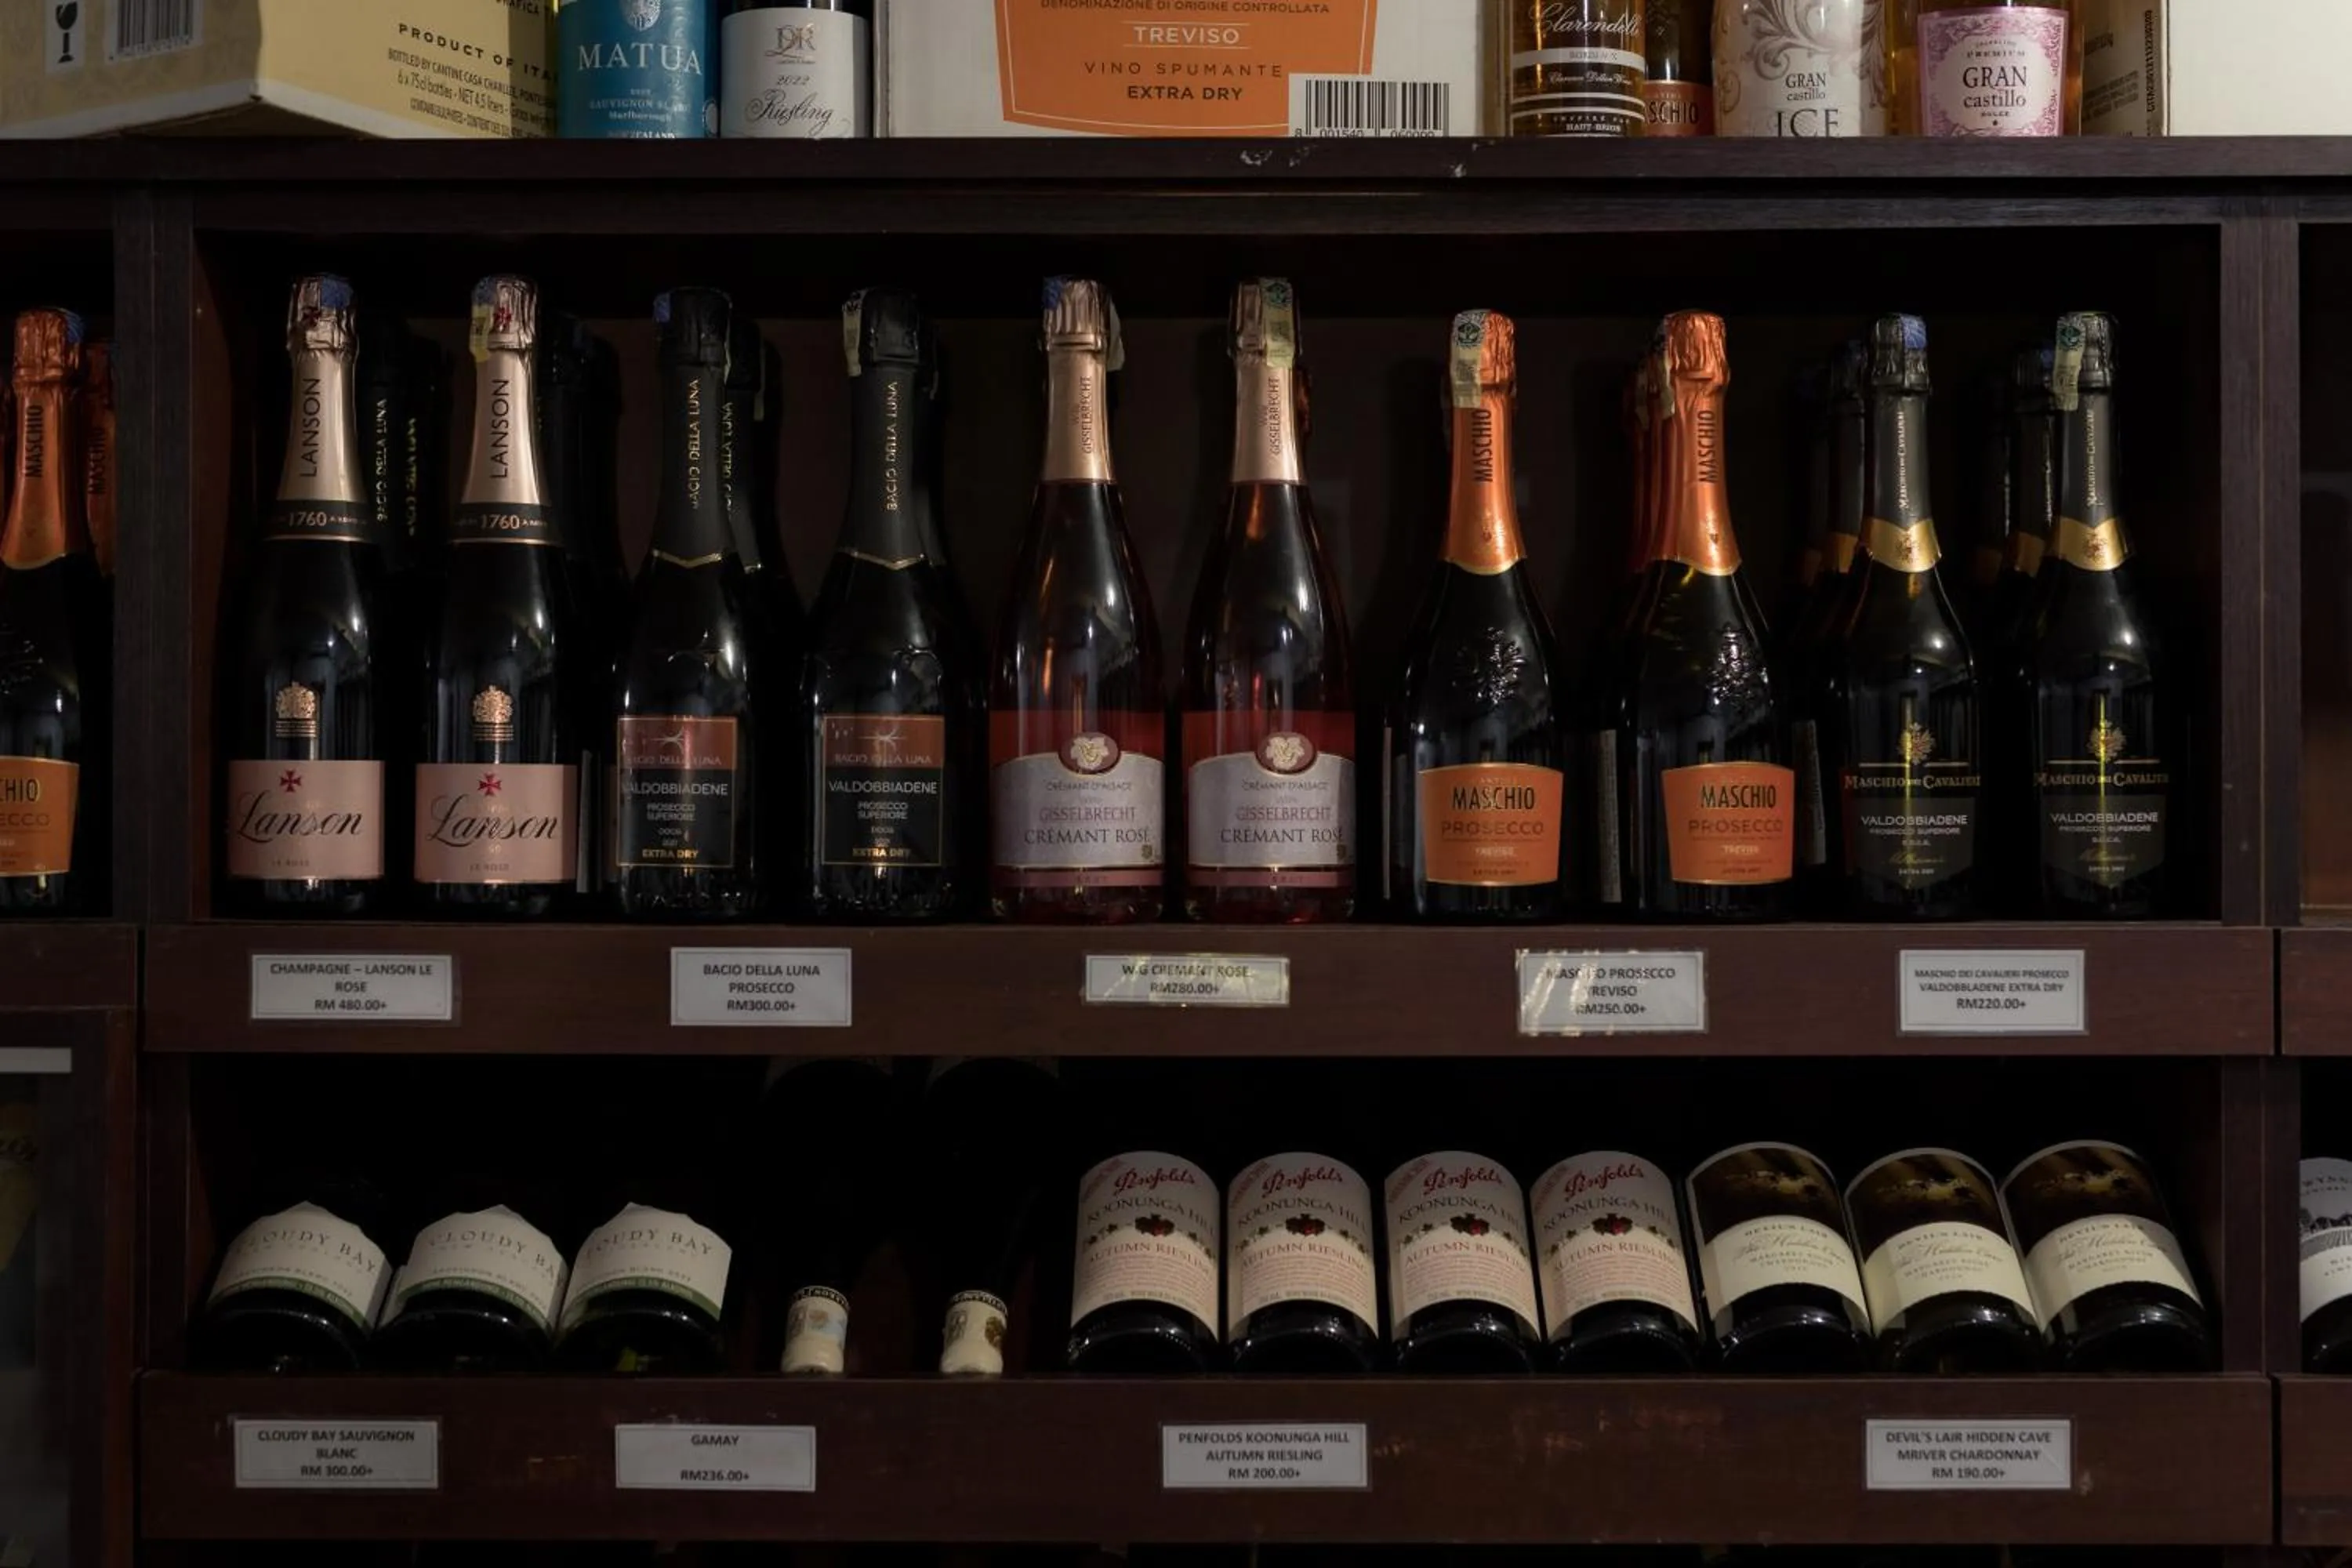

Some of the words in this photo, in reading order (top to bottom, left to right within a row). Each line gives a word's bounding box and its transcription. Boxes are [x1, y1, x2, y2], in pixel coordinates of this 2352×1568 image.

[1175, 0, 1229, 12] ORIGINE
[1232, 1, 1330, 13] CONTROLLATA
[1134, 27, 1240, 44] TREVISO
[399, 24, 484, 59] PRODUCT
[493, 54, 514, 67] OF
[578, 42, 702, 75] MATUA
[1084, 62, 1142, 74] VINO
[1156, 64, 1283, 77] SPUMANTE
[1963, 65, 2027, 88] GRAN
[776, 74, 810, 85] 2022
[1785, 73, 1827, 88] GRAN
[1127, 85, 1194, 100] EXTRA
[1203, 87, 1243, 100] DRY
[1787, 87, 1826, 100] castillo
[1964, 89, 2026, 108] castillo
[1645, 101, 1700, 125] SCHIO
[1776, 108, 1839, 138] ICE
[689, 378, 701, 416] LUNA
[300, 377, 321, 477] LANSON
[491, 379, 510, 479] LANSON
[25, 405, 44, 478] MASCHIO
[1472, 409, 1494, 483] MASCHIO
[1697, 409, 1720, 483] MASCHIO
[289, 510, 328, 528] 1760
[481, 514, 521, 530] 1760
[828, 780, 938, 795] VALDOBBIADENE
[1843, 774, 1906, 789] MASCHIO
[0, 779, 38, 802] HIO
[1700, 785, 1777, 809] MASCHIO
[1453, 786, 1536, 811] MASCHIO
[237, 789, 363, 844] Lanson
[426, 793, 558, 848] Lanson
[1040, 806, 1137, 822] GISSELBRECHT
[1236, 806, 1332, 822] GISSELBRECHT
[1861, 815, 1969, 826] VALDOBBIADENE
[2050, 811, 2158, 823] VALDOBBIADENE
[1441, 820, 1544, 836] PROSECCO
[1688, 818, 1782, 833] PROSECCO
[642, 848, 675, 859] EXTRA
[677, 848, 699, 859] DRY
[270, 964, 350, 975] CHAMPAGNE
[365, 964, 416, 975] LANSON
[419, 964, 433, 975] LE
[703, 964, 742, 976] BACIO
[746, 964, 783, 975] DELLA
[786, 965, 821, 977] LUNA
[1609, 968, 1675, 980] PROSECCO
[2022, 970, 2071, 979] PROSECCO
[335, 982, 367, 993] ROSE
[729, 982, 795, 994] PROSECCO
[1150, 983, 1220, 995] RM280.00+
[1590, 985, 1638, 997] REVISO
[2009, 982, 2041, 993] EXTRA
[2043, 982, 2064, 993] DRY
[314, 1000, 335, 1011] RM
[339, 1000, 387, 1011] 480.00+
[727, 1000, 796, 1011] RM300.00+
[1576, 1004, 1647, 1015] RM250.00+
[1956, 998, 2027, 1010] RM220.00+
[1113, 1167, 1195, 1196] Penfolds
[1262, 1166, 1343, 1198] Penfolds
[1423, 1166, 1503, 1196] Penfolds
[1564, 1163, 1644, 1202] Penfolds
[672, 1232, 713, 1255] BAY
[258, 1430, 309, 1442] CLOUDY
[311, 1430, 336, 1441] BAY
[339, 1430, 415, 1442] SAUVIGNON
[691, 1434, 740, 1446] GAMAY
[1178, 1432, 1243, 1444] PENFOLDS
[1246, 1432, 1321, 1443] KOONUNGA
[1324, 1433, 1350, 1444] HILL
[1886, 1432, 1933, 1443] DEVIL'S
[1936, 1432, 1962, 1443] LAIR
[1966, 1432, 2016, 1443] HIDDEN
[2018, 1432, 2053, 1443] CAVE
[316, 1448, 358, 1459] BLANC
[1206, 1450, 1265, 1461] AUTUMN
[1267, 1450, 1323, 1461] RIESLING
[1897, 1449, 1947, 1461] MRIVER
[1949, 1449, 2041, 1460] CHARDONNAY
[300, 1465, 321, 1476] RM
[326, 1465, 374, 1477] 300.00+
[680, 1470, 750, 1482] RM236.00+
[1229, 1468, 1250, 1479] RM
[1253, 1468, 1301, 1479] 200.00+
[1932, 1467, 1953, 1479] RM
[1957, 1467, 2006, 1479] 190.00+
